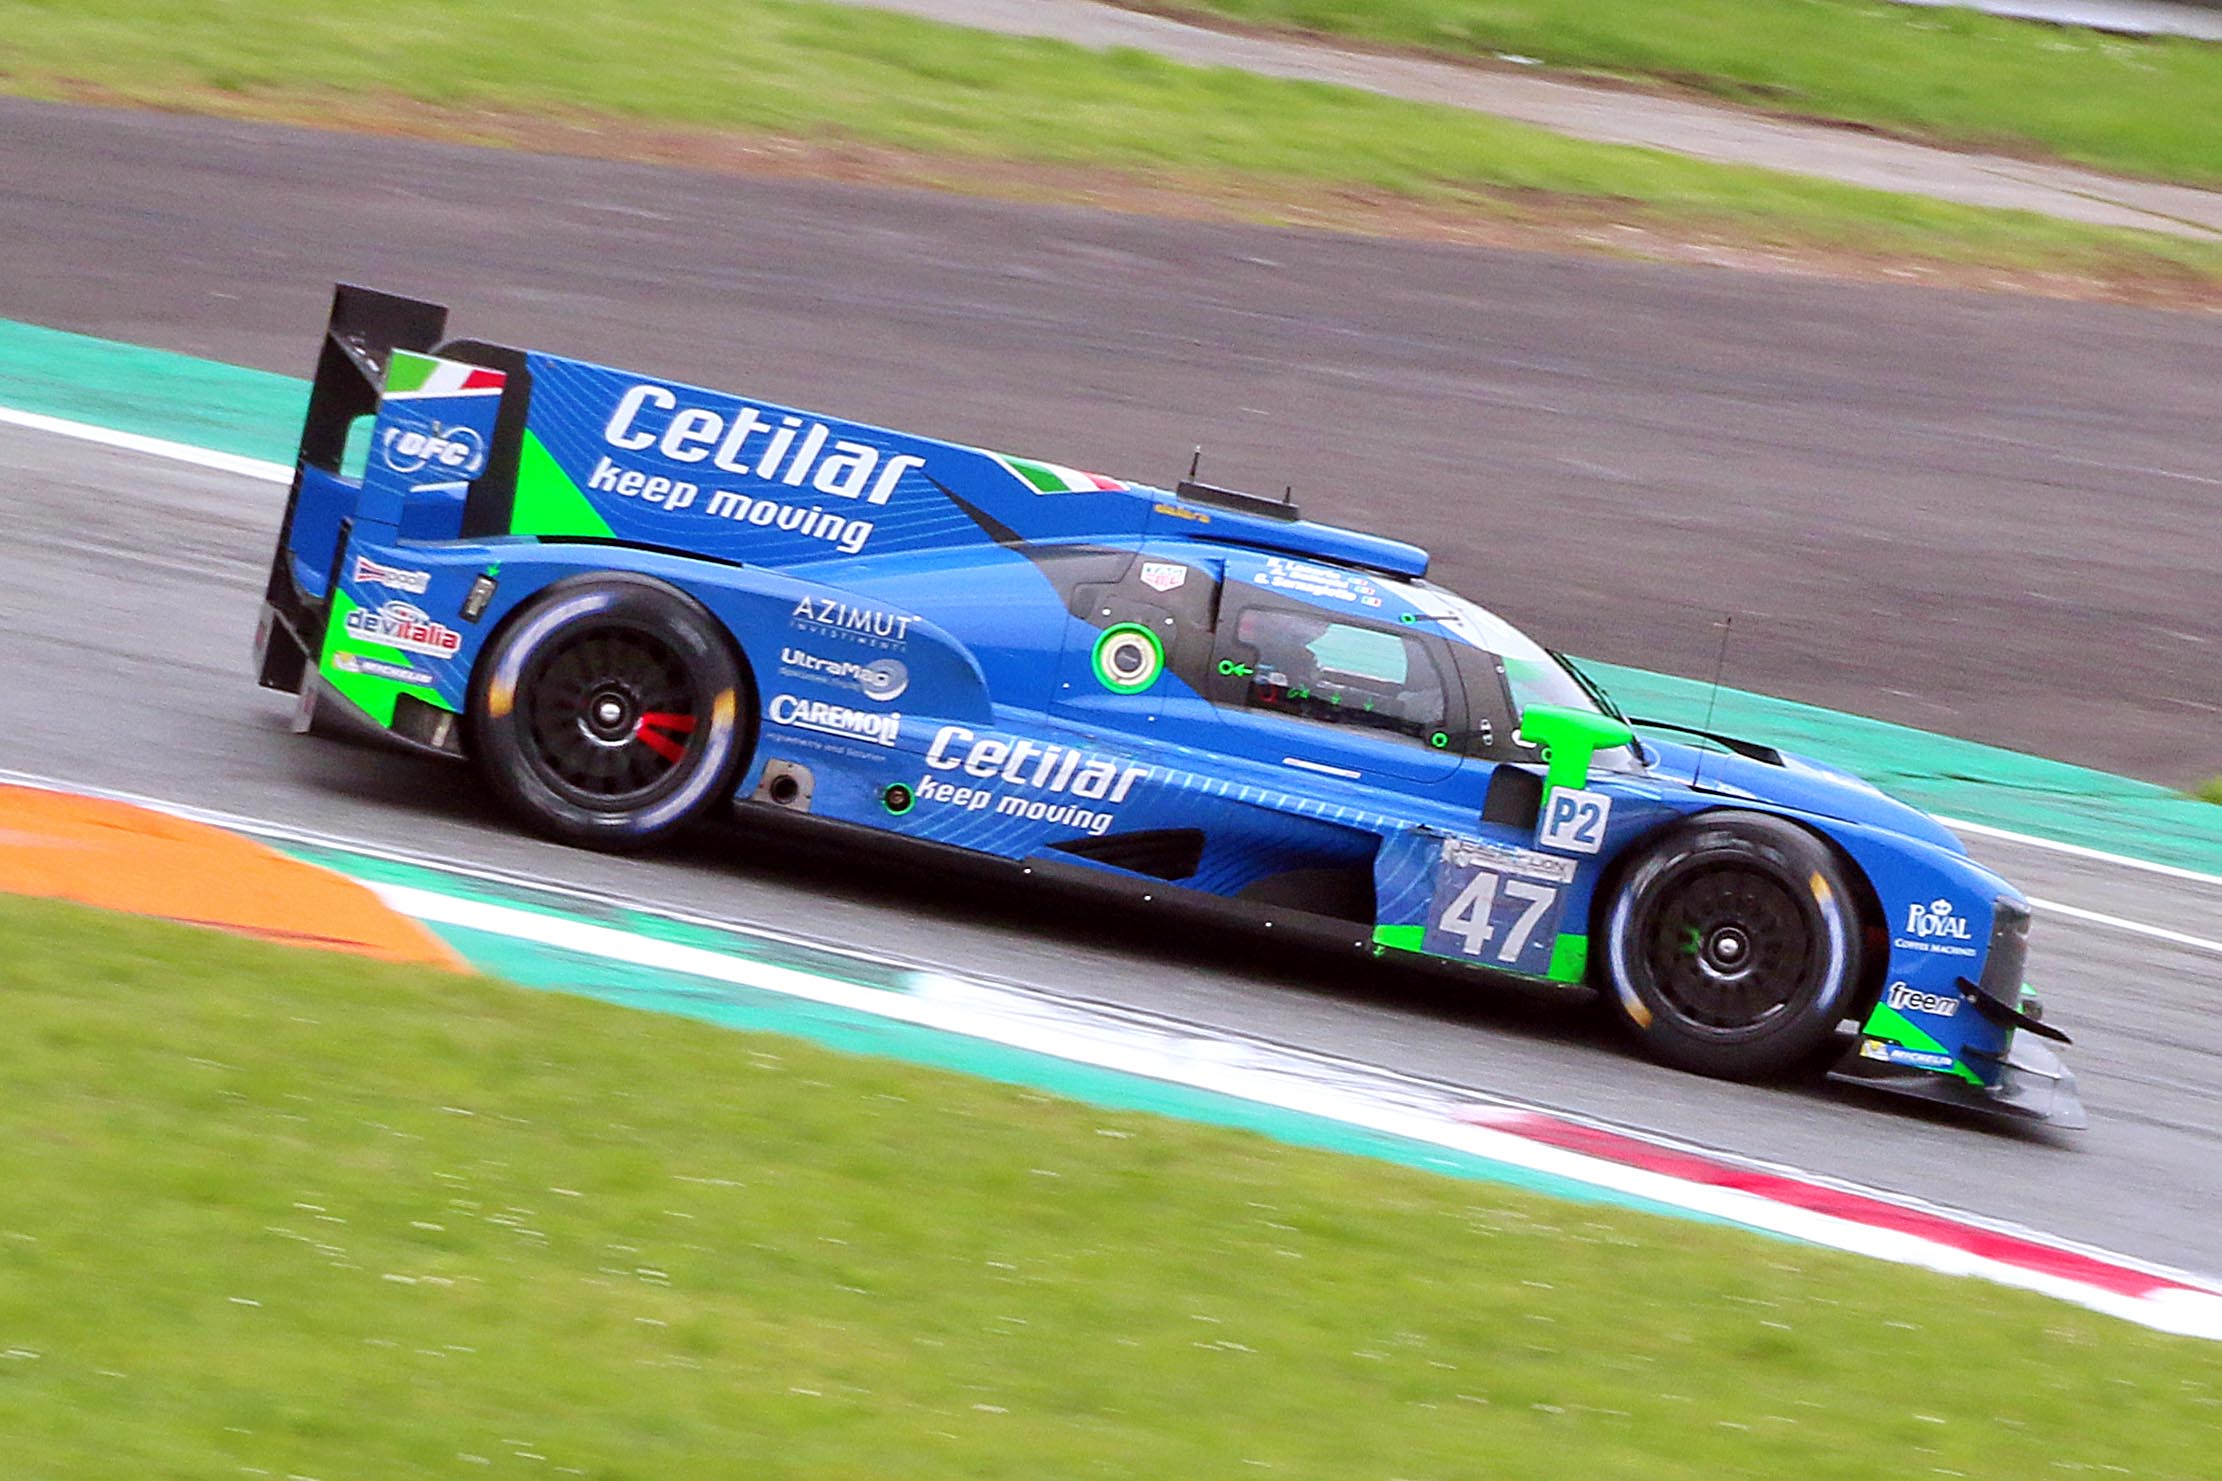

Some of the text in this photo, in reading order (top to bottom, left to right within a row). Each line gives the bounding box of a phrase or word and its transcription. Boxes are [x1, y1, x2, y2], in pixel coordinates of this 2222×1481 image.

[604, 385, 926, 505] Cetilar
[588, 456, 875, 554] keep moving
[346, 609, 460, 650] devitalia
[793, 596, 912, 639] AZIMUT
[925, 725, 1148, 804] Cetilar
[915, 775, 1114, 836] keep moving
[1550, 797, 1600, 844] P2
[1439, 872, 1558, 962] 47
[1906, 904, 1972, 939] ROYAL
[1889, 982, 1958, 1015] freem
